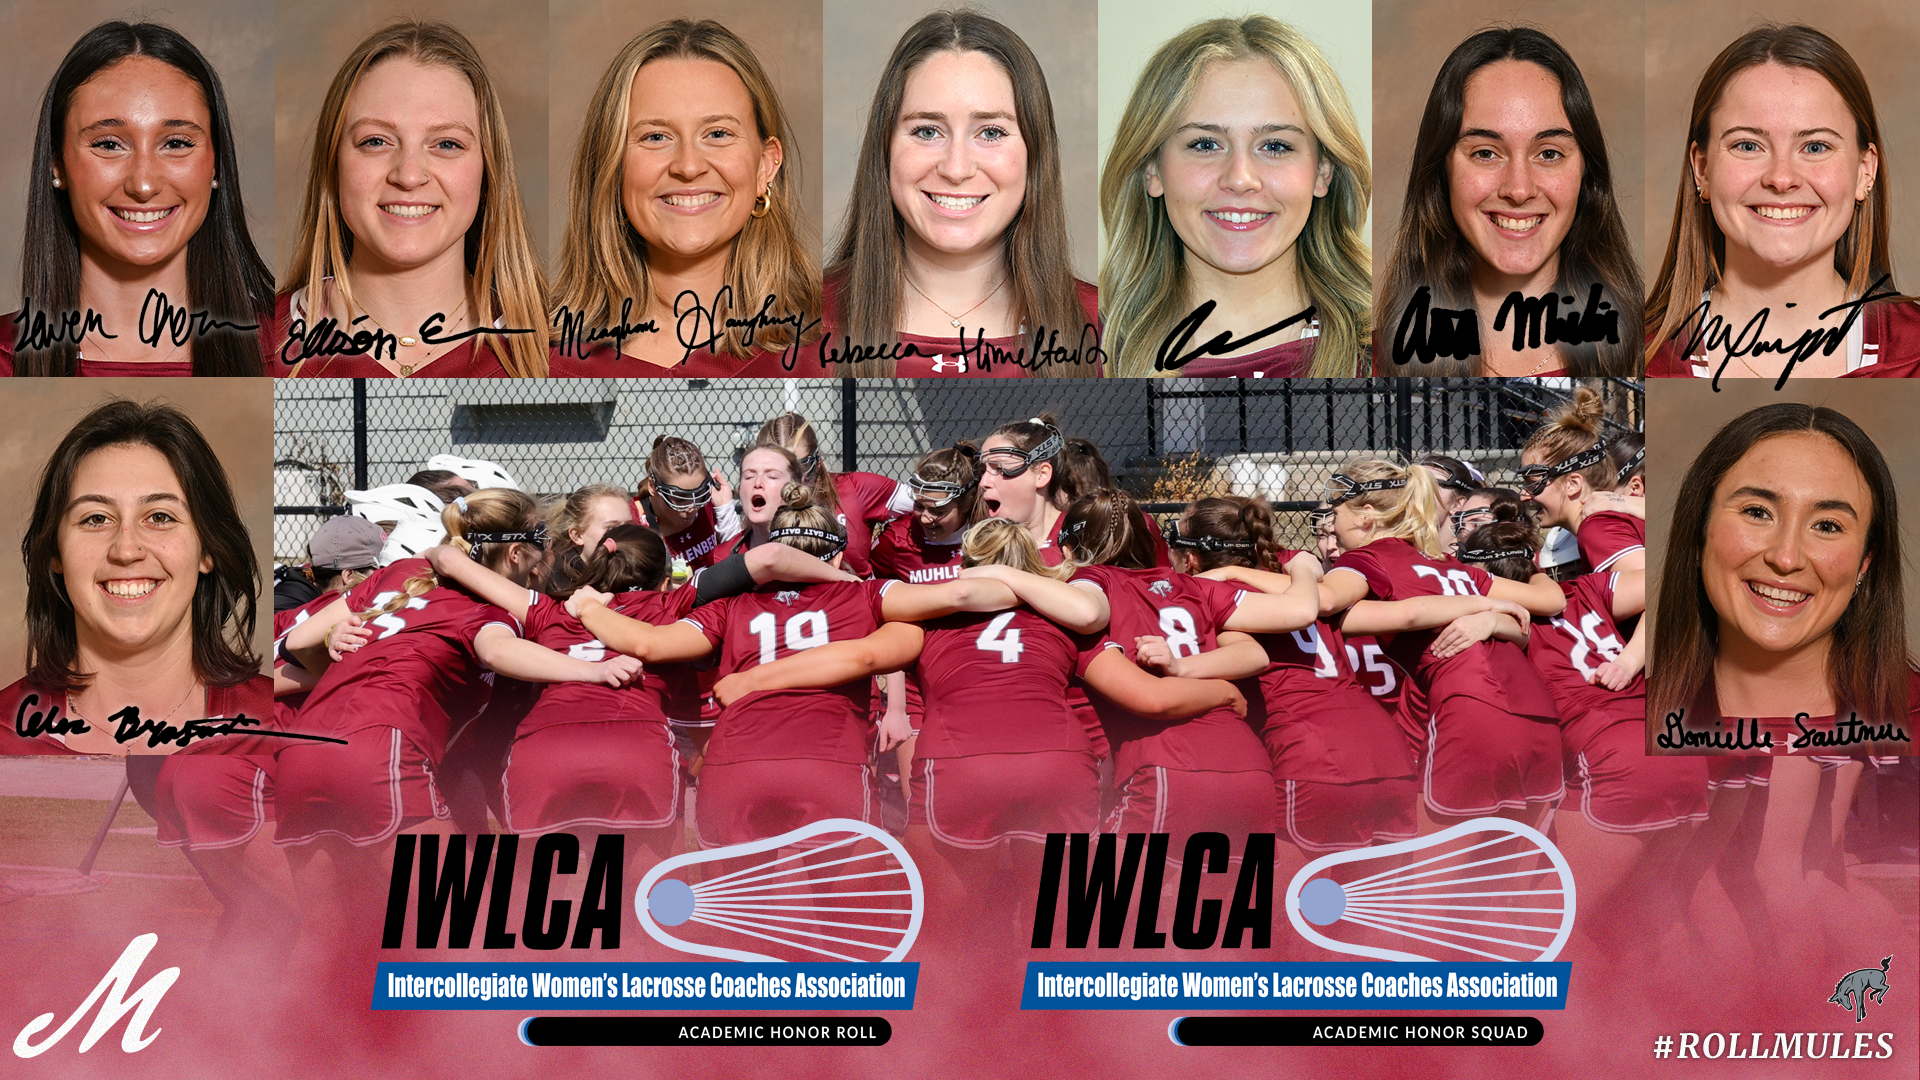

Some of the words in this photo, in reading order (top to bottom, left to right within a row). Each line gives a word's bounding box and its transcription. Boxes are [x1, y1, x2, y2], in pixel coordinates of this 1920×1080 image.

[501, 532, 527, 541] STX
[749, 608, 832, 666] 19
[974, 610, 1025, 664] 4
